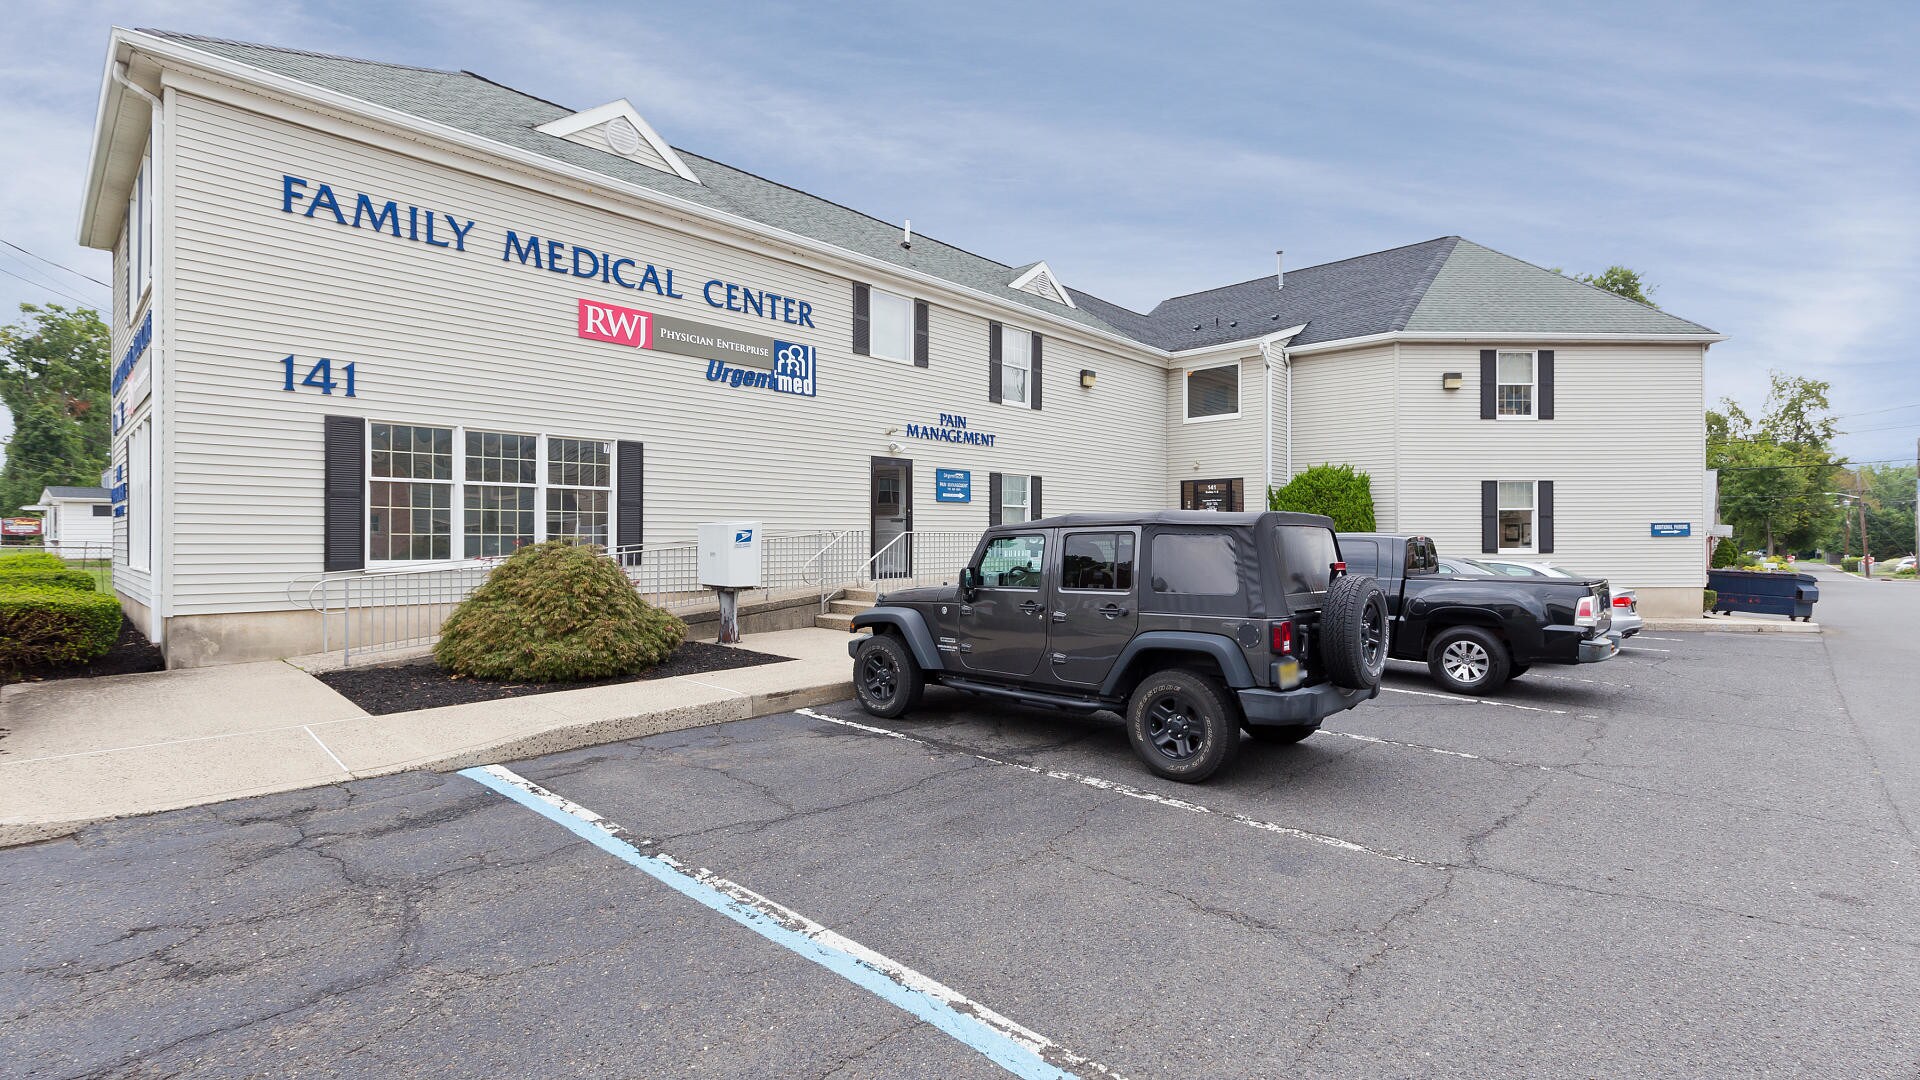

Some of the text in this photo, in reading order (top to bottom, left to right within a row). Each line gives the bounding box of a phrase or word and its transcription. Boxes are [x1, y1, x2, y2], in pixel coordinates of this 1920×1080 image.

[283, 175, 814, 328] FAMILY MEDICAL CENTER
[584, 304, 770, 357] RWJ PHYSICIAN ENTERPRISE
[282, 355, 356, 398] 141
[906, 424, 996, 446] MANAGEMENT
[939, 413, 967, 429] PAIN
